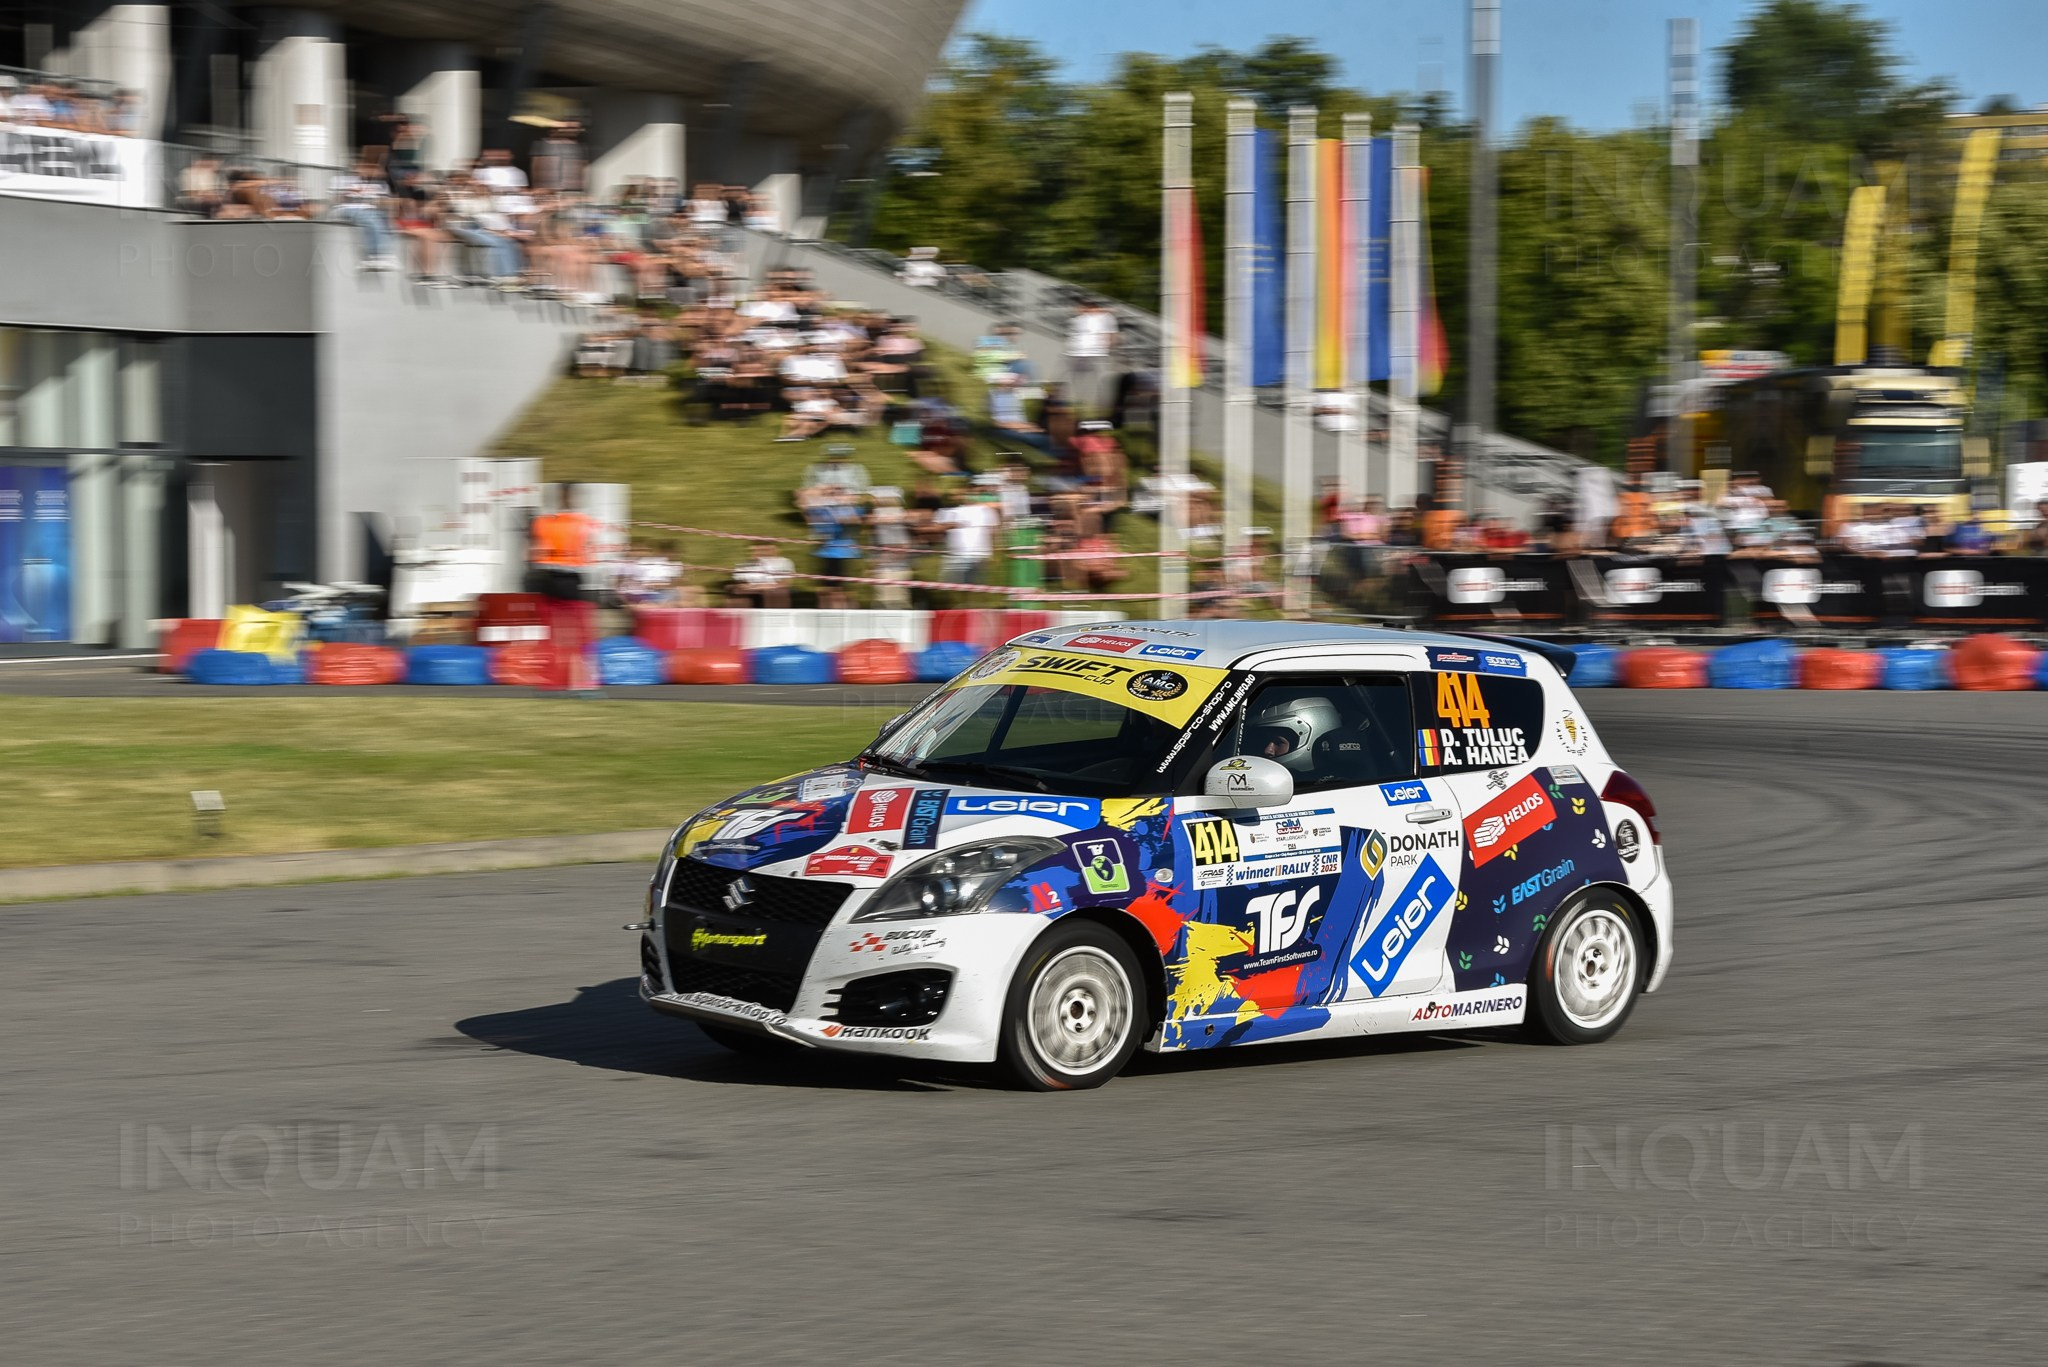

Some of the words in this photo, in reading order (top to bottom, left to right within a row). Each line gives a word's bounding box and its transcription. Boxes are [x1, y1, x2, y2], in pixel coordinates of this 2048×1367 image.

[1100, 638, 1134, 648] HELIOS
[1016, 655, 1135, 678] SWIFT
[1083, 674, 1116, 686] CUP
[1143, 676, 1176, 690] AMC
[1437, 671, 1491, 729] 414
[1156, 681, 1232, 773] www.sparco-shop.ro
[1440, 728, 1461, 747] D.
[1462, 727, 1526, 747] TULUC
[1443, 746, 1463, 766] A.
[1466, 745, 1530, 766] HANEA
[1384, 785, 1424, 801] Leier
[867, 802, 890, 829] HELIOS
[956, 799, 1090, 817] Leier
[1503, 792, 1544, 826] HELIOS
[1194, 819, 1240, 865] 414
[1390, 830, 1459, 852] DONATH
[1320, 863, 1338, 873] 2025
[1321, 854, 1338, 864] CNR
[1390, 854, 1418, 867] PARK
[1235, 866, 1276, 881] winner
[1282, 861, 1311, 876] RALLY
[1511, 859, 1575, 905] EASTGrain
[1245, 885, 1320, 954] TFS
[1361, 875, 1436, 982] Leier
[883, 929, 937, 941] BUCUR
[1243, 948, 1318, 970] www.TeamFirstSoftware.ro
[1411, 995, 1523, 1021] AUTOMARINERO
